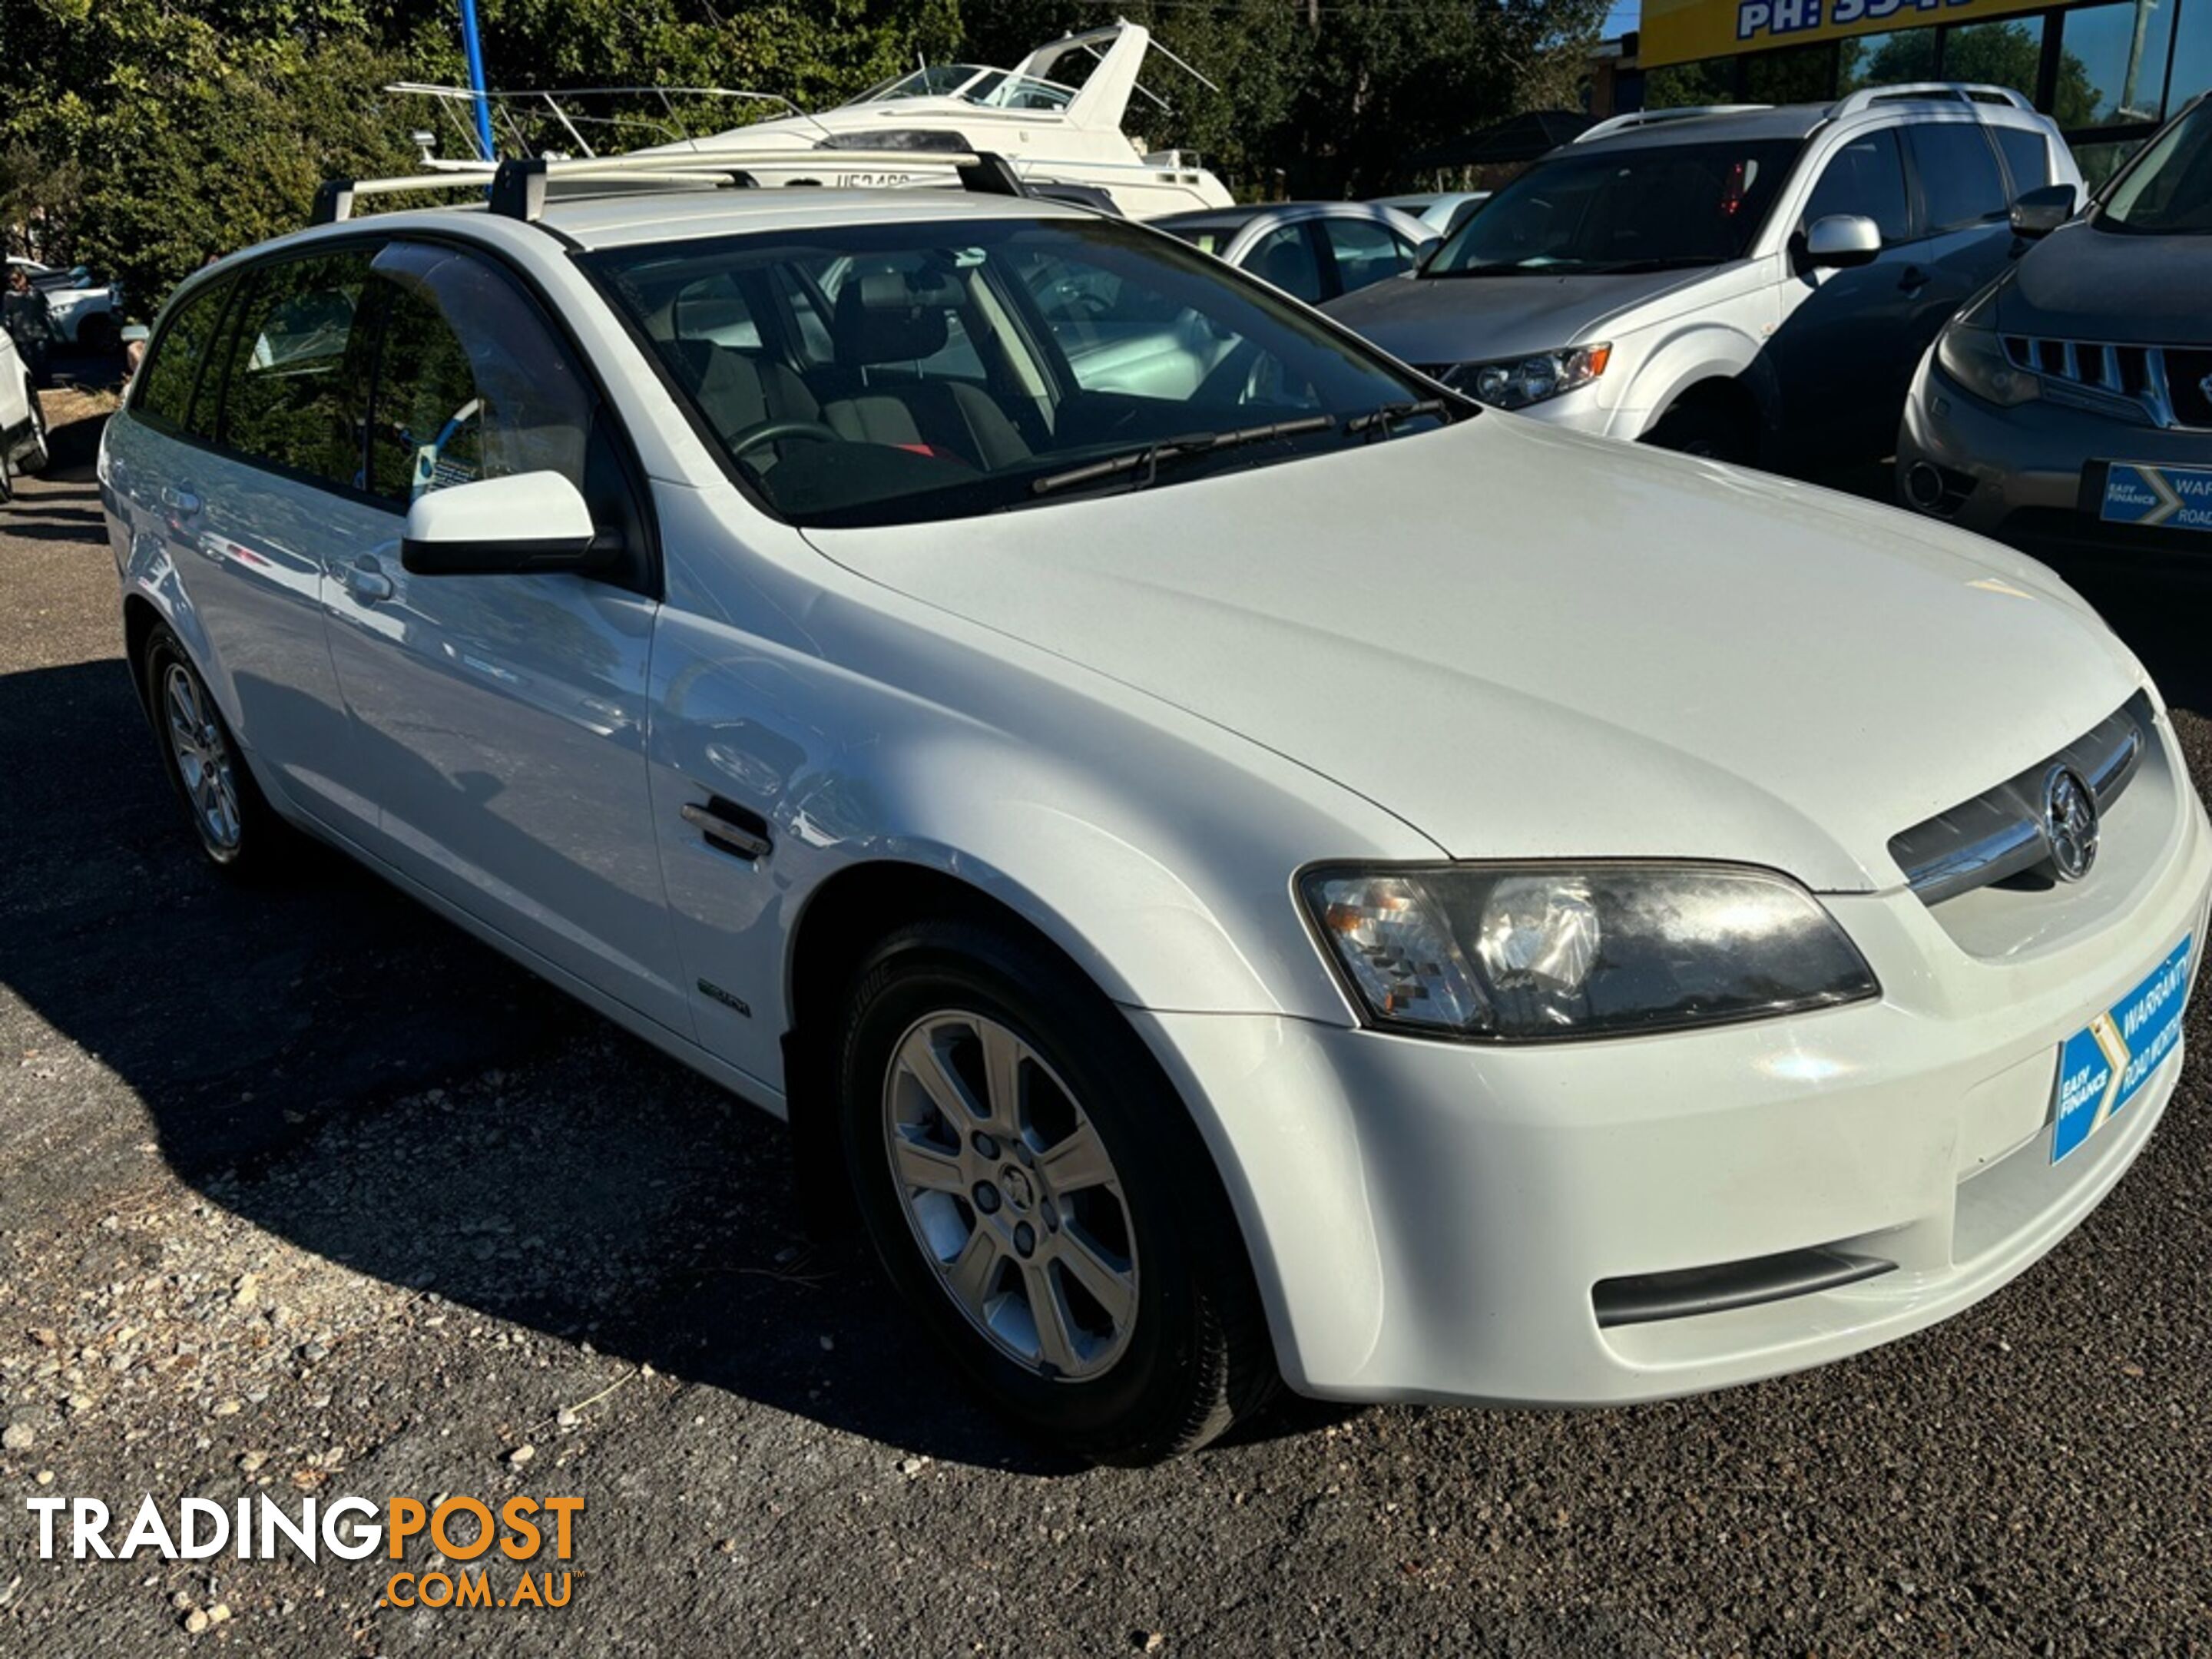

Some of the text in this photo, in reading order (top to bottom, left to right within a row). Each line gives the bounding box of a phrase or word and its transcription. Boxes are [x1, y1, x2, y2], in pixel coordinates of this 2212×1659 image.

[2107, 492, 2157, 506] FINANCE
[2109, 483, 2137, 494] EASY
[2060, 1068, 2108, 1120] FINANCE
[2062, 1065, 2091, 1100] EASY
